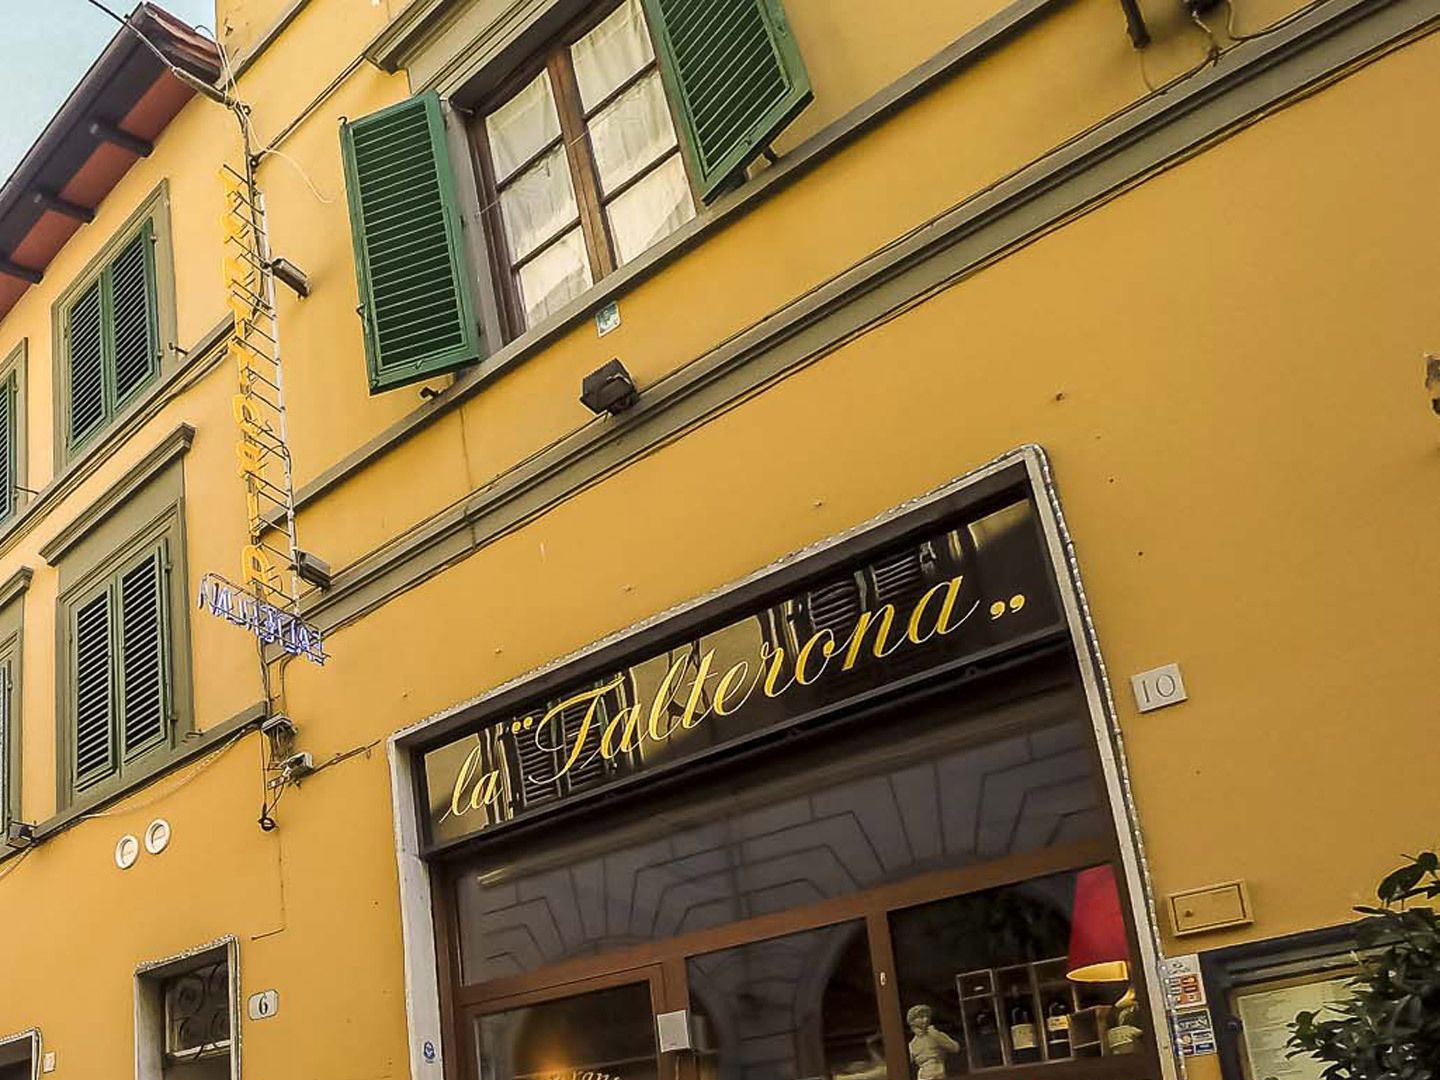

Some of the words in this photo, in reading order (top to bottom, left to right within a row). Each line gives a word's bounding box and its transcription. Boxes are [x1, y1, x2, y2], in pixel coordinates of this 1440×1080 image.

[1141, 673, 1177, 704] 10
[439, 745, 504, 824] la
[258, 993, 269, 1016] 6
